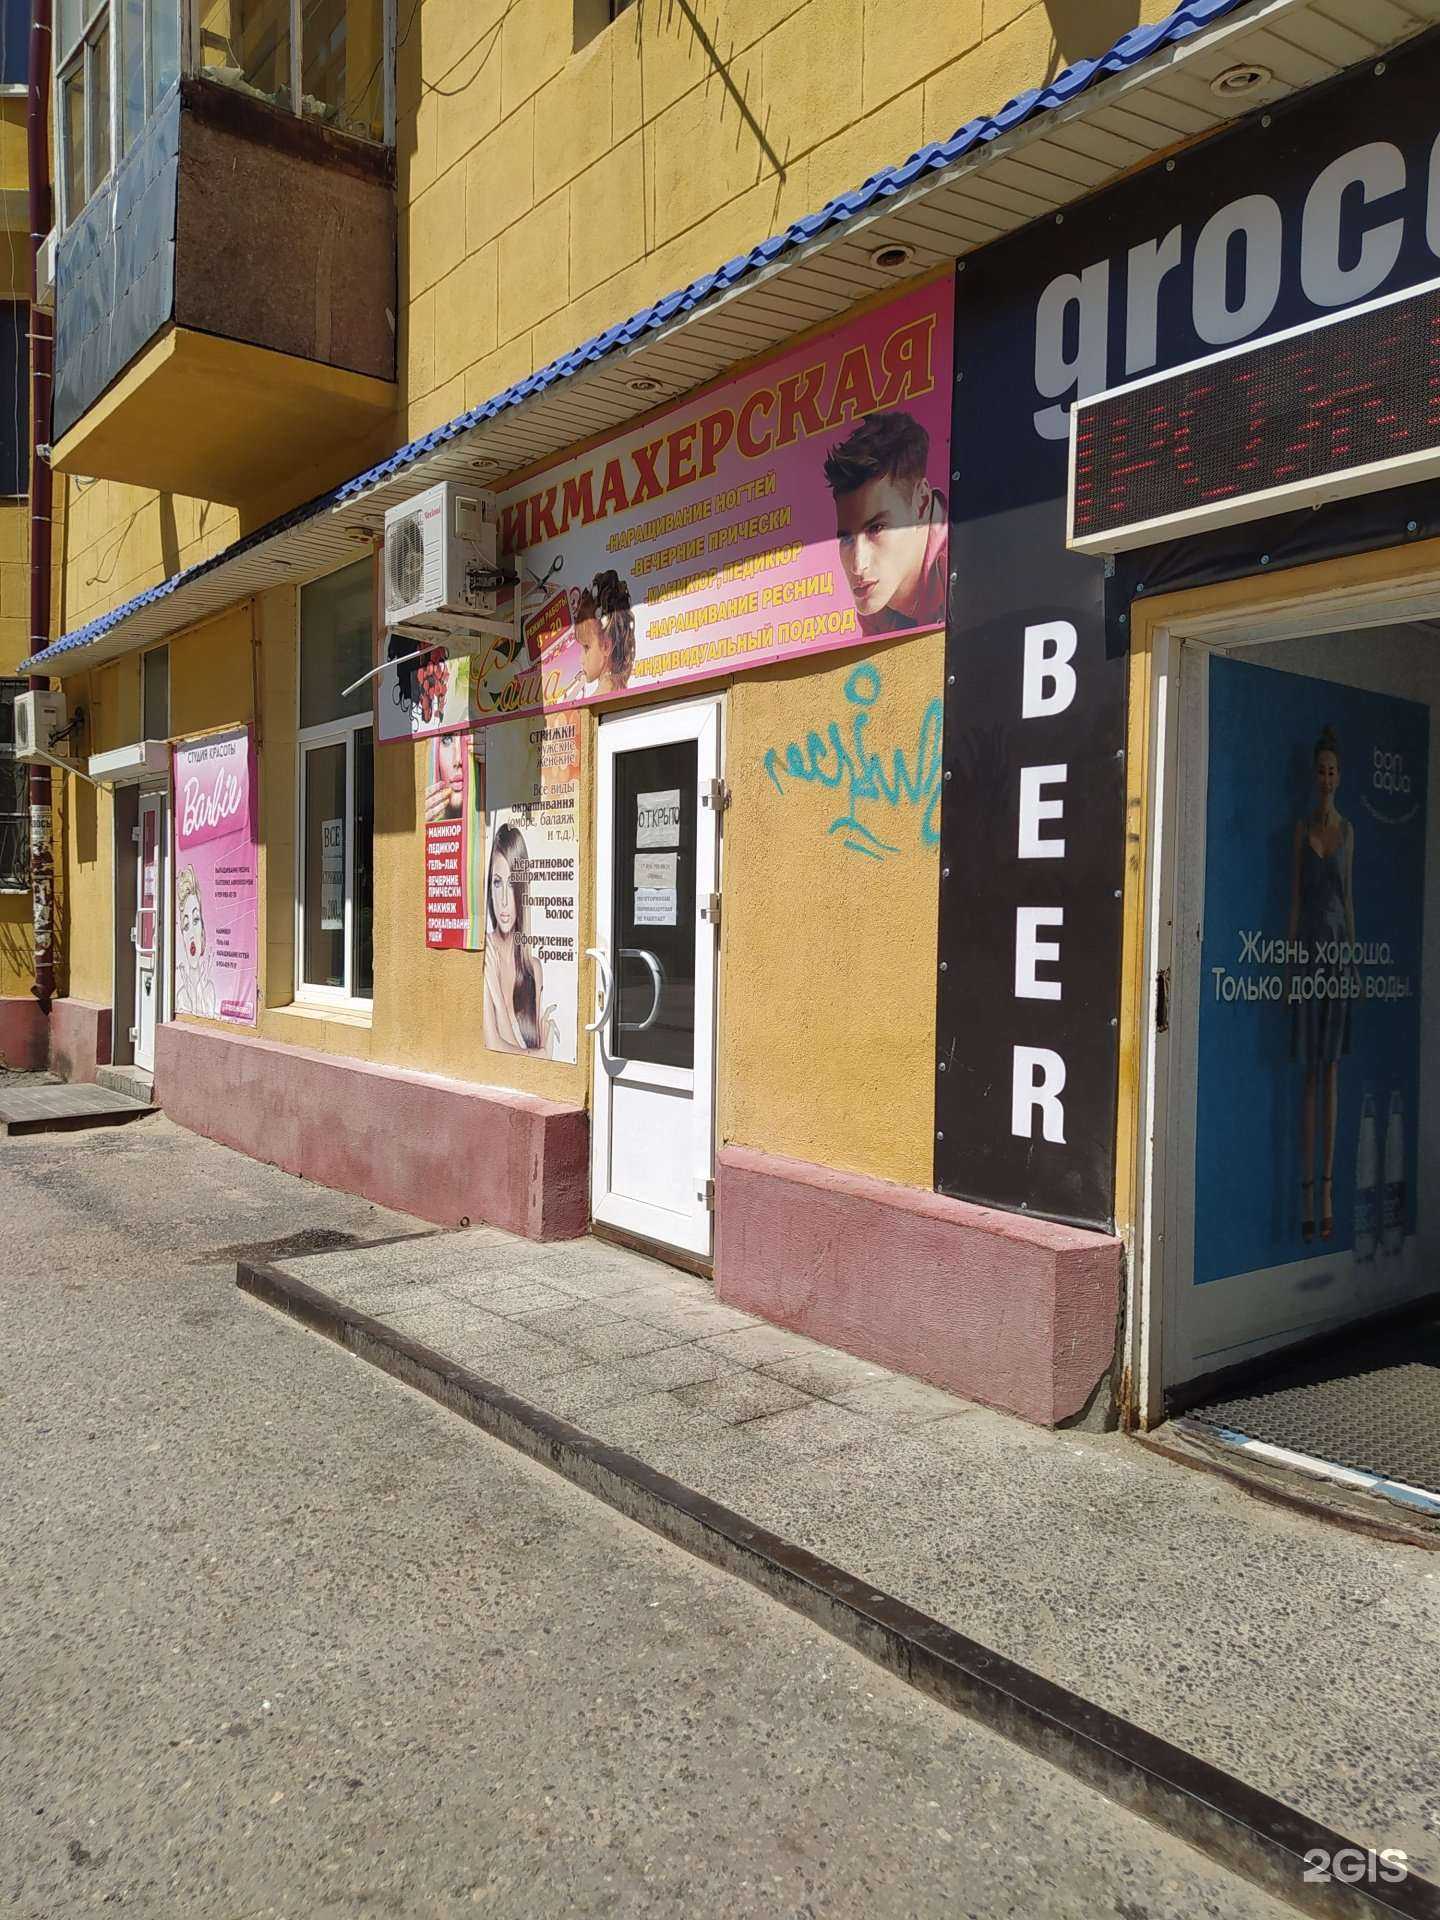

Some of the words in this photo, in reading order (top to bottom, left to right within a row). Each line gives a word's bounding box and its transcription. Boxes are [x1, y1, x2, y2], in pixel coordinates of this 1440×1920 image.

[500, 313, 937, 556] ИКМАХЕРСКАЯ
[712, 473, 777, 515] НОГТЕЙ
[707, 505, 793, 553] ПРИЧЕСКИ
[761, 571, 835, 610] РЕСНИЦ
[777, 607, 858, 645] ПОДХОД
[529, 725, 575, 745] СТРИЖКИ
[209, 743, 237, 760] КРАСОТЫ
[533, 783, 548, 797] Все
[550, 783, 575, 795] виды
[182, 766, 242, 837] Barbie
[511, 798, 575, 816] окрашивания
[540, 811, 575, 826] балаяж
[638, 806, 680, 828] ОТКРЫТО
[323, 826, 341, 848] ВСЕ
[428, 825, 462, 838] МАНИКЮР
[428, 842, 460, 855] ПЕДИКЮР
[513, 857, 574, 871] Кератиновое
[510, 870, 574, 883] выпрямление
[1011, 620, 1079, 1145] BEER
[428, 886, 462, 898] ПРИЧЕСКИ
[428, 902, 457, 914] МАКИЯЖ
[522, 895, 574, 909] Полировка
[545, 909, 574, 919] волос
[514, 932, 574, 948] Оформление
[1238, 930, 1309, 965] Жизнь
[538, 946, 574, 963] бровей
[1211, 967, 1283, 1002] Только
[1287, 966, 1360, 1004] добавь
[1366, 974, 1414, 1003] воды.
